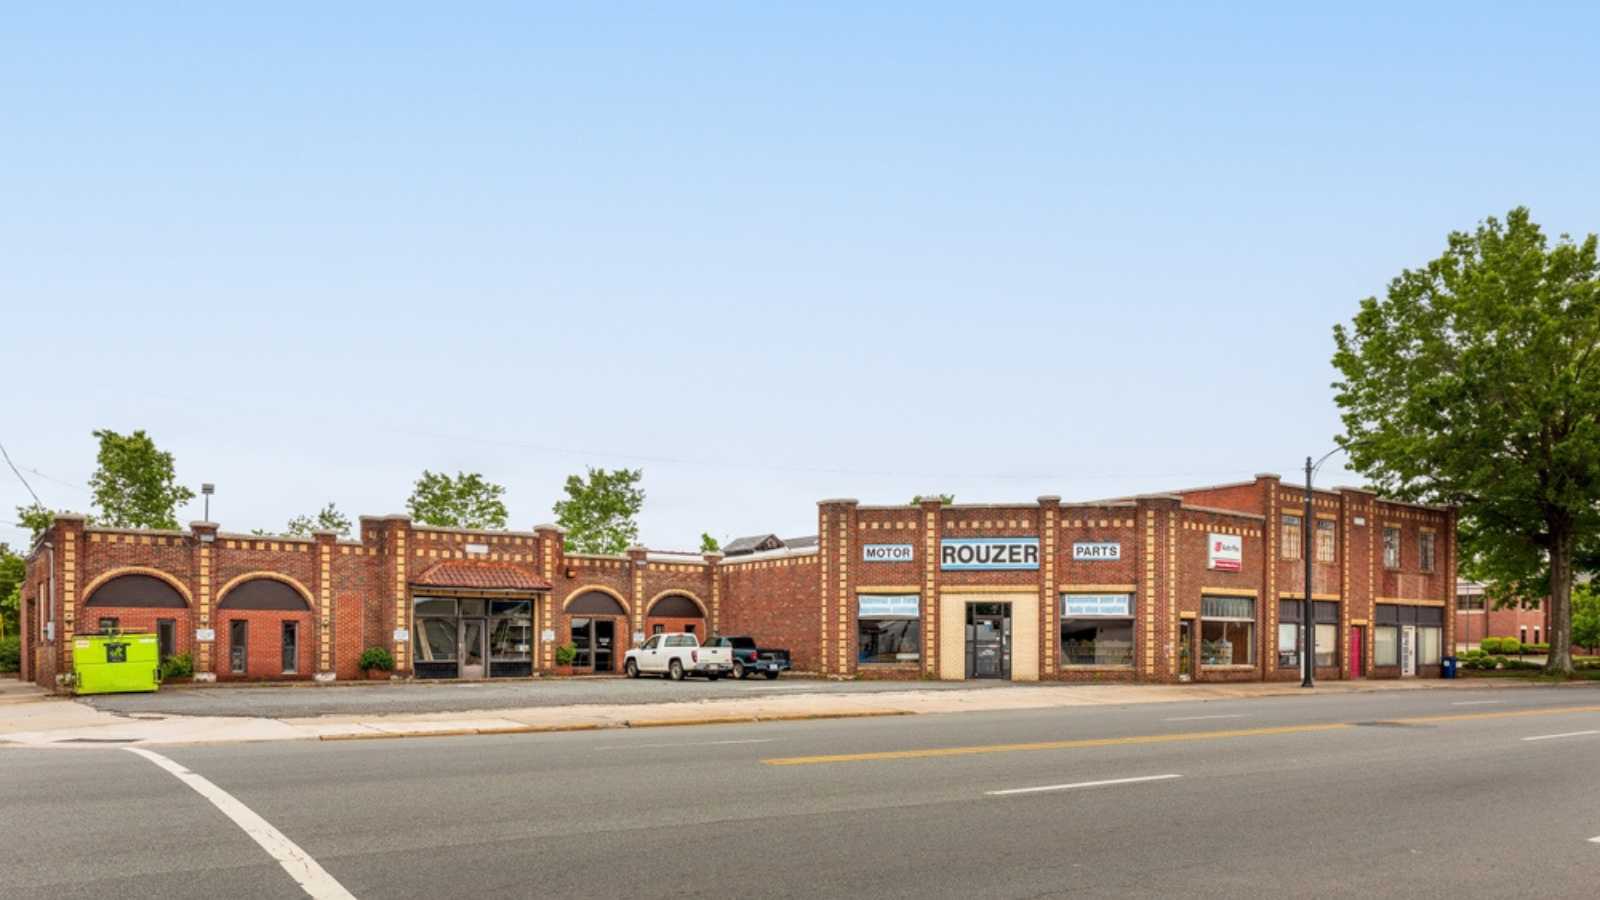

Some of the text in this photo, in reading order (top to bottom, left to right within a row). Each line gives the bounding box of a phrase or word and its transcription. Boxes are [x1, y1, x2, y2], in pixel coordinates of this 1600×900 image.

[866, 547, 910, 558] MOTOR
[942, 544, 1038, 564] ROUZER
[1076, 546, 1118, 556] PARTS
